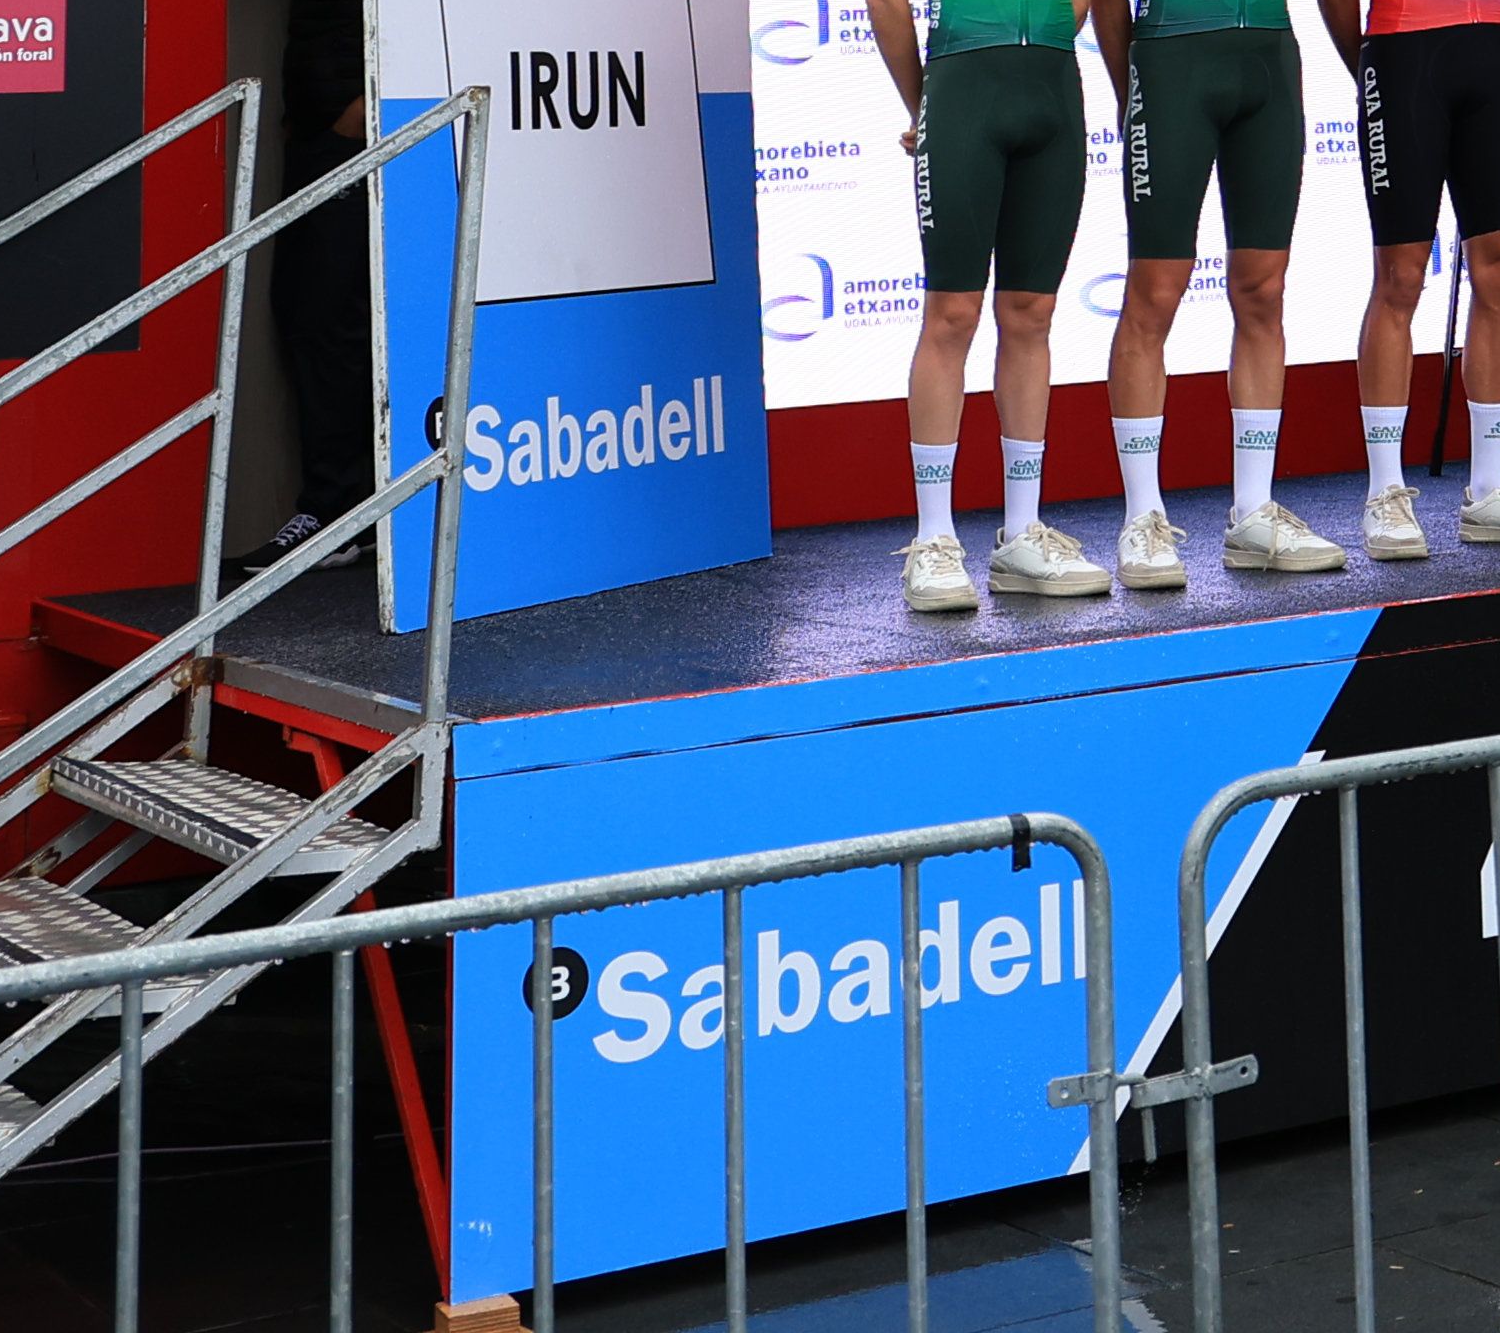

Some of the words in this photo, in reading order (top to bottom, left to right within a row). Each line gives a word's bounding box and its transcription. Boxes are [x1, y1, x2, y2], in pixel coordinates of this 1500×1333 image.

[509, 50, 646, 130] IRUN
[463, 375, 725, 492] Sabadell
[592, 879, 1086, 1064] Sabadell
